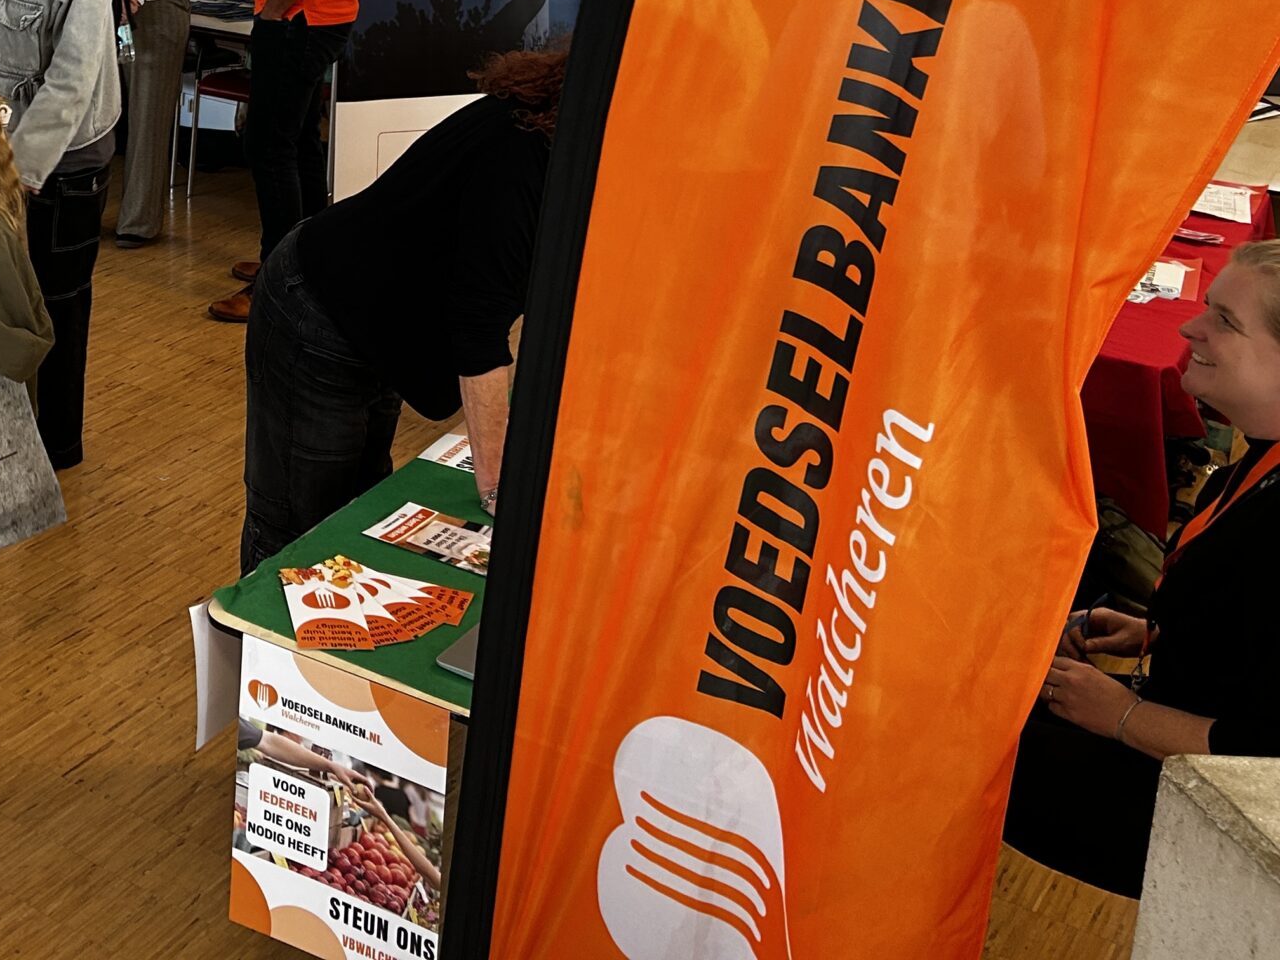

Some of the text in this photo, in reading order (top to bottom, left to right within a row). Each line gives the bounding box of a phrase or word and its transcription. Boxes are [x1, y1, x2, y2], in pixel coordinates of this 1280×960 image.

[794, 408, 935, 793] Walcheren
[281, 708, 321, 731] Walcheren
[281, 696, 383, 746] VOEDSELBANKEN.NL
[272, 776, 306, 799] VOOR
[259, 790, 317, 822] IEDEREEN
[263, 809, 311, 837] DIE ONS
[247, 821, 326, 861] NODIG HEEFT
[329, 897, 436, 960] STEUN ONS
